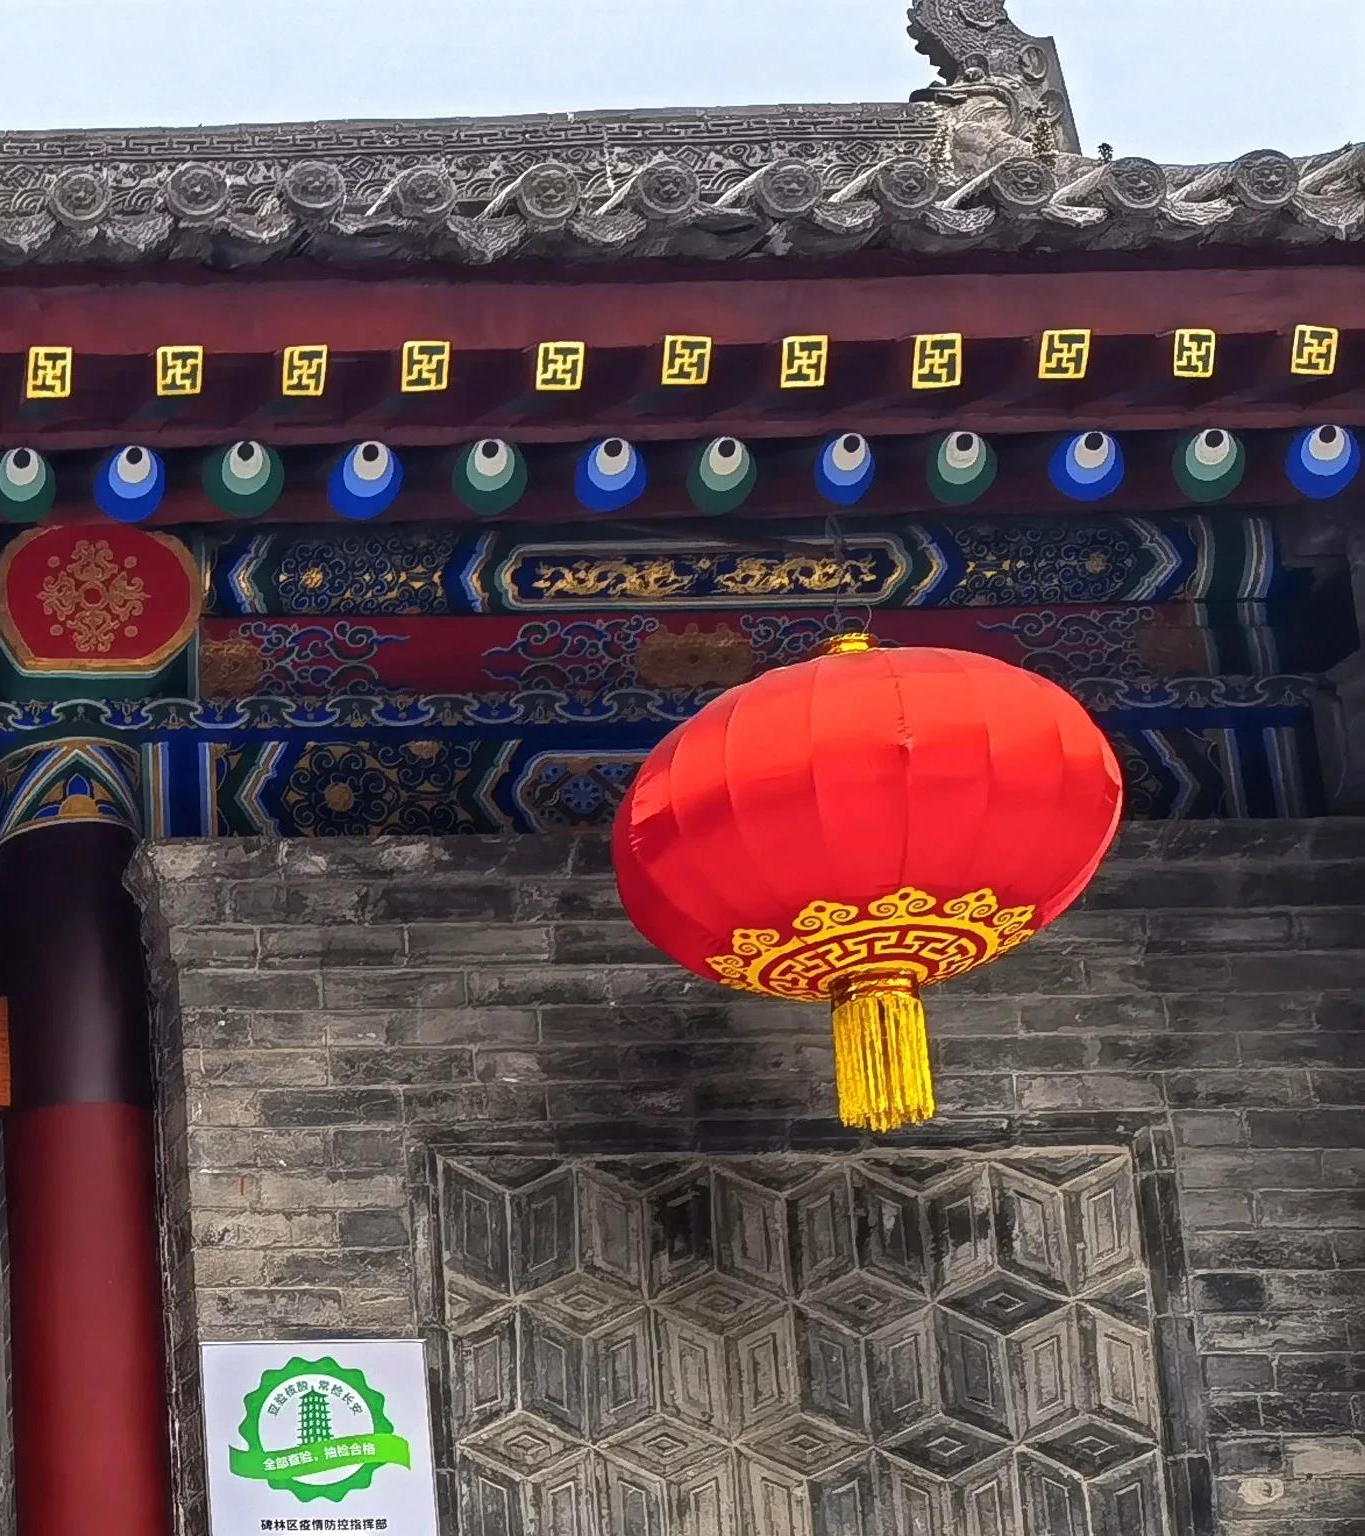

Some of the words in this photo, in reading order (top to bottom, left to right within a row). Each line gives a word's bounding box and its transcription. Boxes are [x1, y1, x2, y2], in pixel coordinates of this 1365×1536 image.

[260, 1518, 389, 1531] 碑林区疫情防控指挥部
